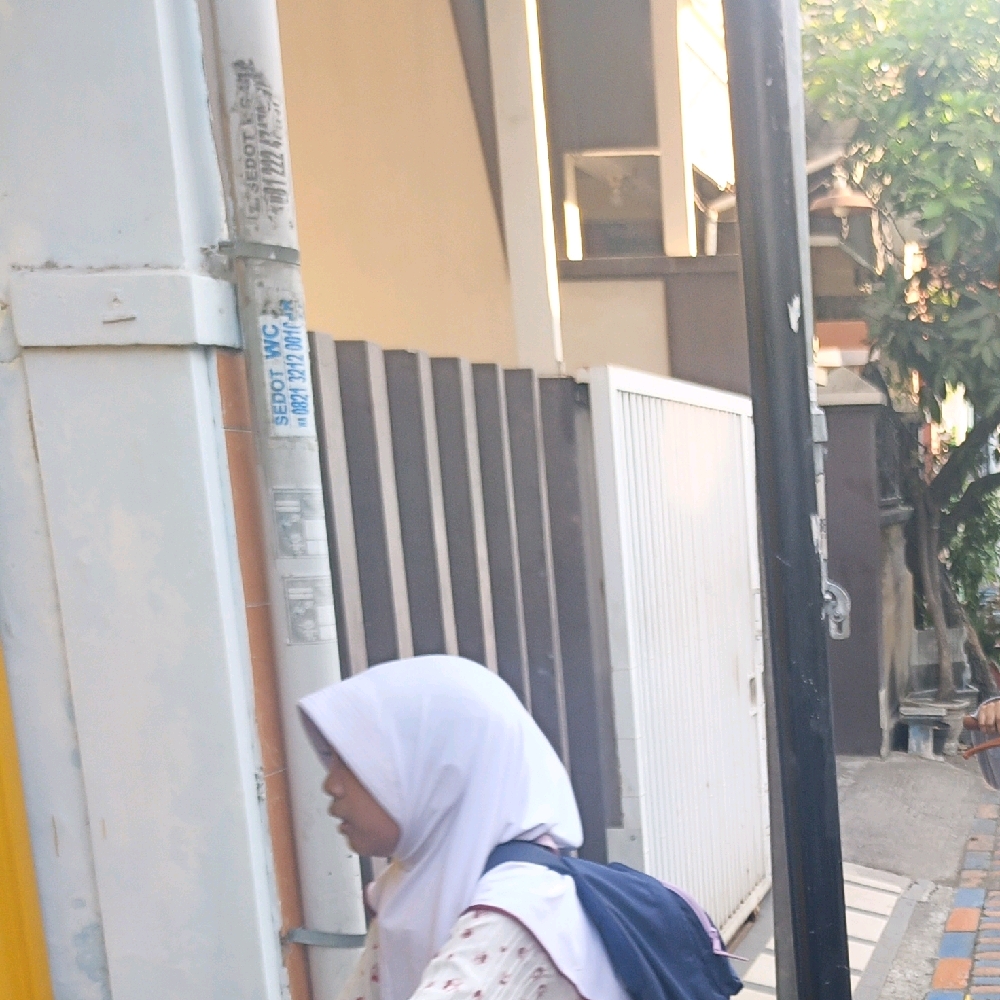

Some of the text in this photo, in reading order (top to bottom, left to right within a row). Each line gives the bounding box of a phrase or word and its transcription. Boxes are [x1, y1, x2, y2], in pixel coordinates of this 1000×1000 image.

[262, 324, 289, 426] SEDOT WC
[286, 354, 307, 382] 3212
[288, 388, 309, 415] 0821
